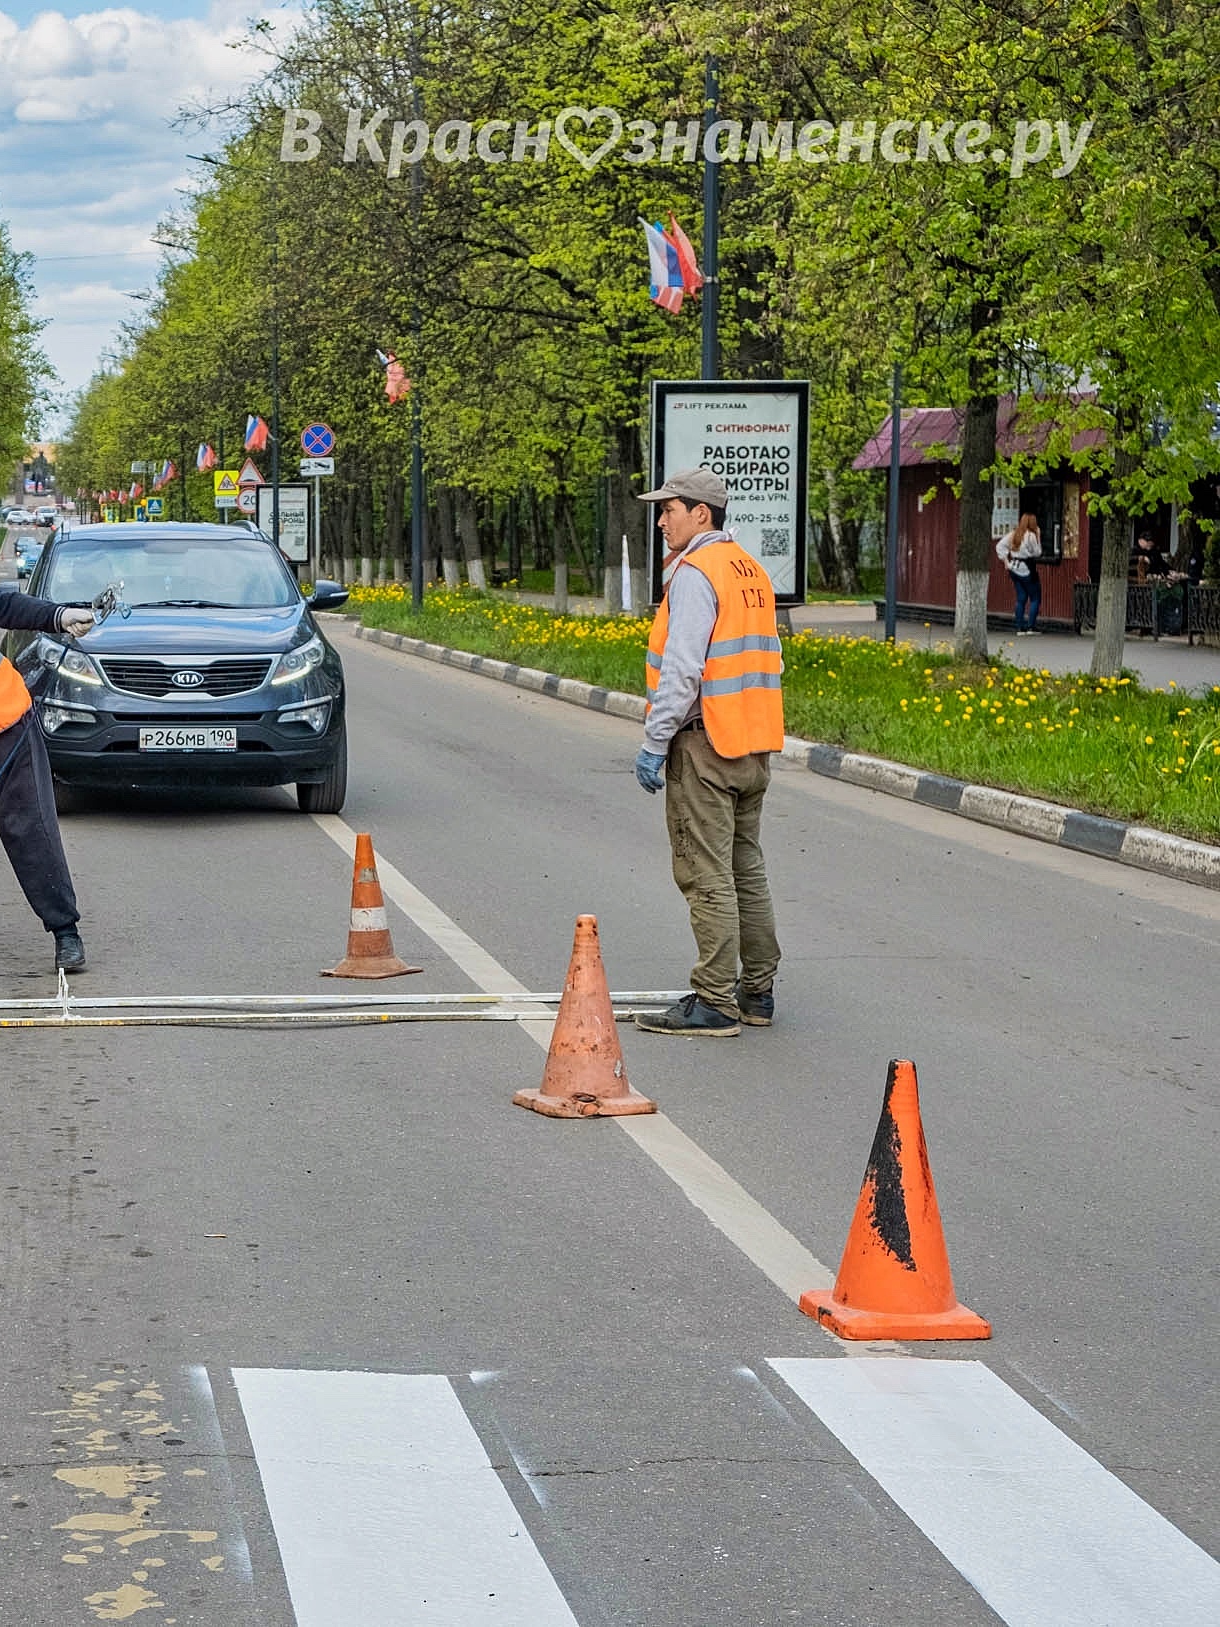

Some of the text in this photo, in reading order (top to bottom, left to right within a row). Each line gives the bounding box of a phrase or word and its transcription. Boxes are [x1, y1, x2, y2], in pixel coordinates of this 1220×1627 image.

[706, 424, 791, 433] Я СИТИФОРМАТ
[703, 446, 790, 459] РАБОТАЮ
[721, 478, 789, 491] МОТРЫ
[749, 493, 765, 501] без
[735, 513, 790, 523] 490-25-65
[177, 674, 199, 684] KIA
[210, 730, 233, 741] 190
